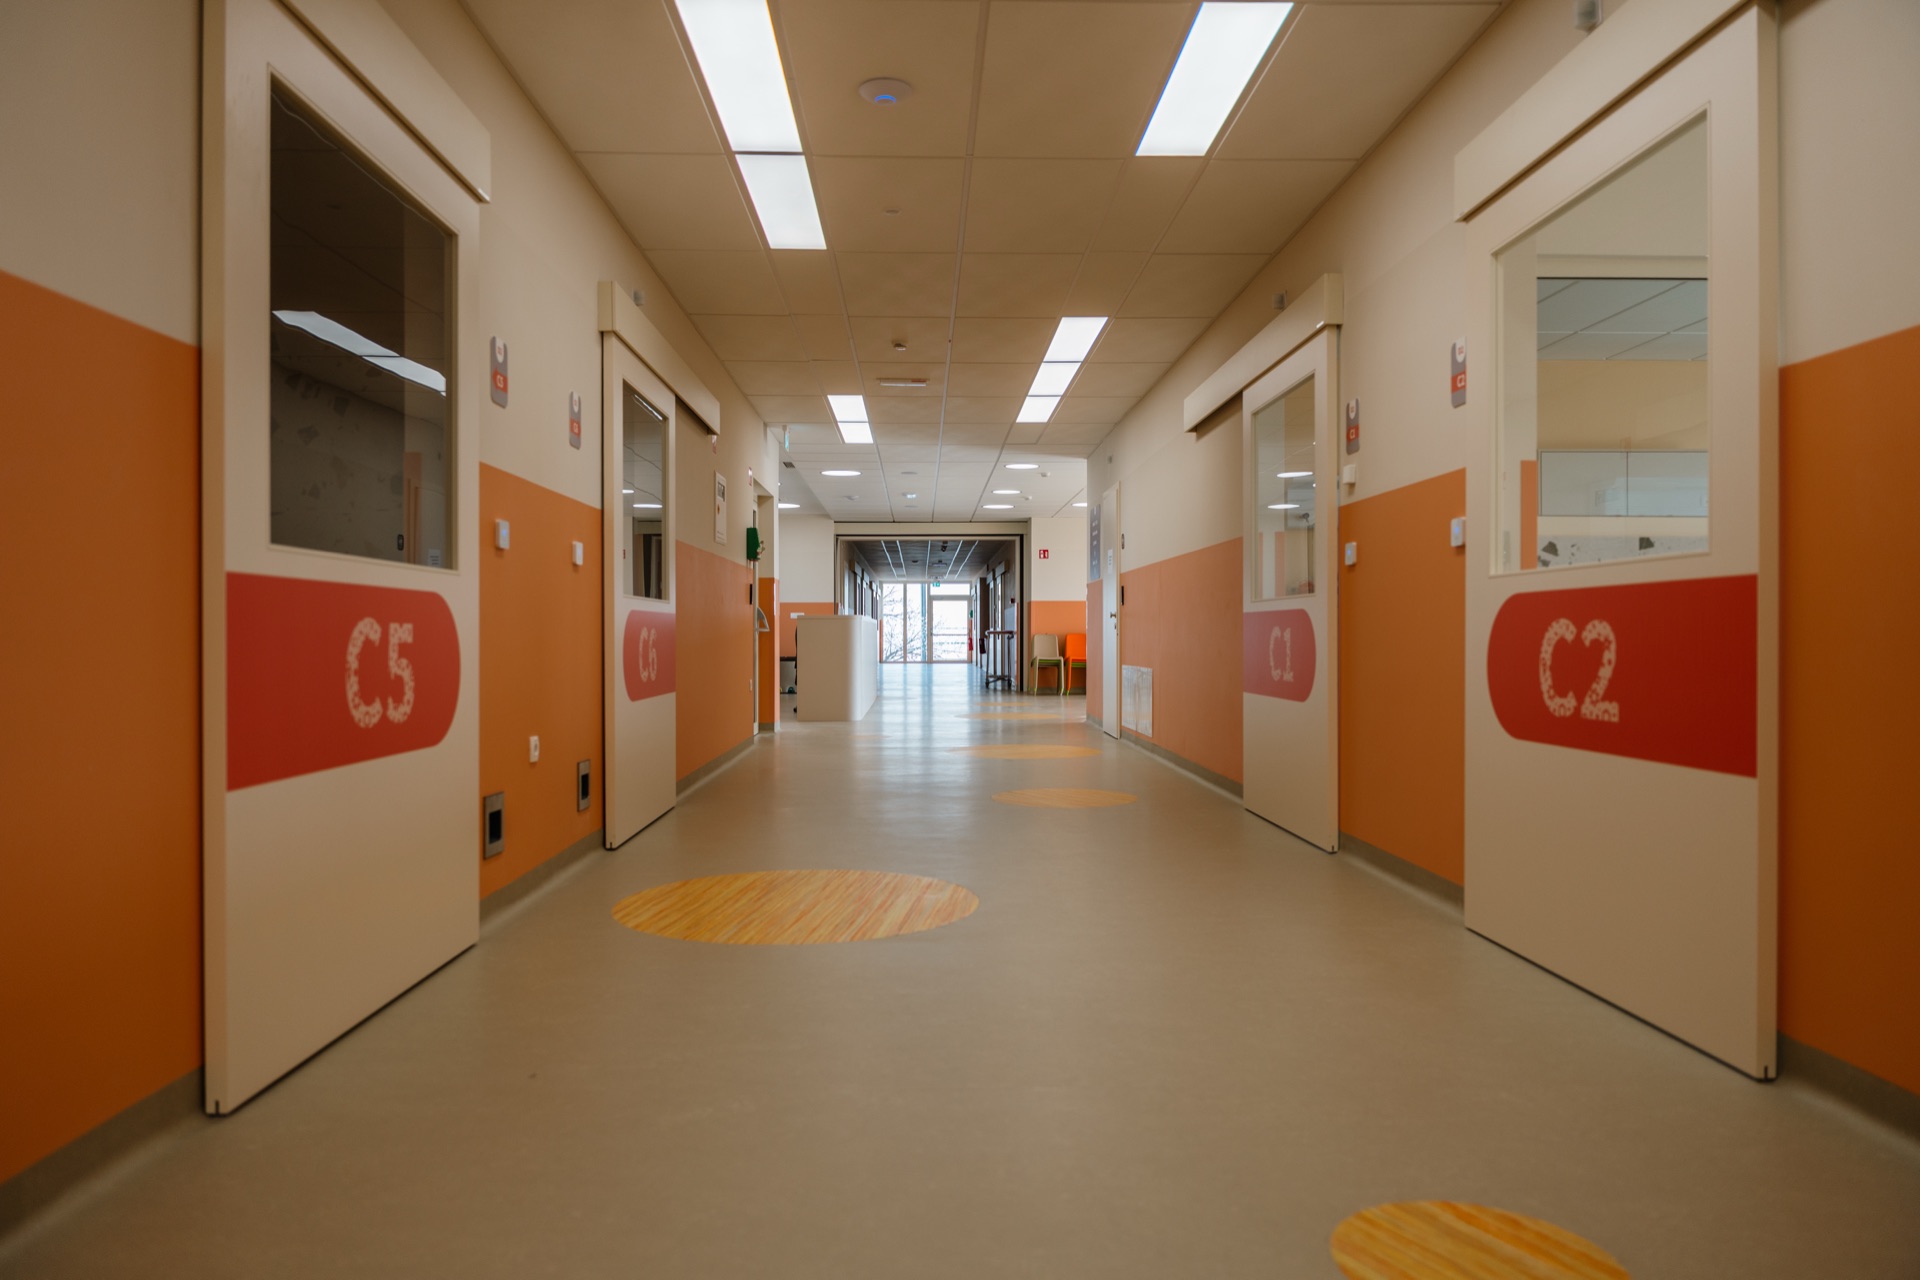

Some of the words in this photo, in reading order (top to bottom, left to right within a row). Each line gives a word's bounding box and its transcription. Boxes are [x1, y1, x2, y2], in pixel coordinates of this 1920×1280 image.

[345, 616, 415, 728] C5
[639, 626, 657, 682] C6
[1269, 626, 1294, 682] C1
[1539, 617, 1620, 723] C2
